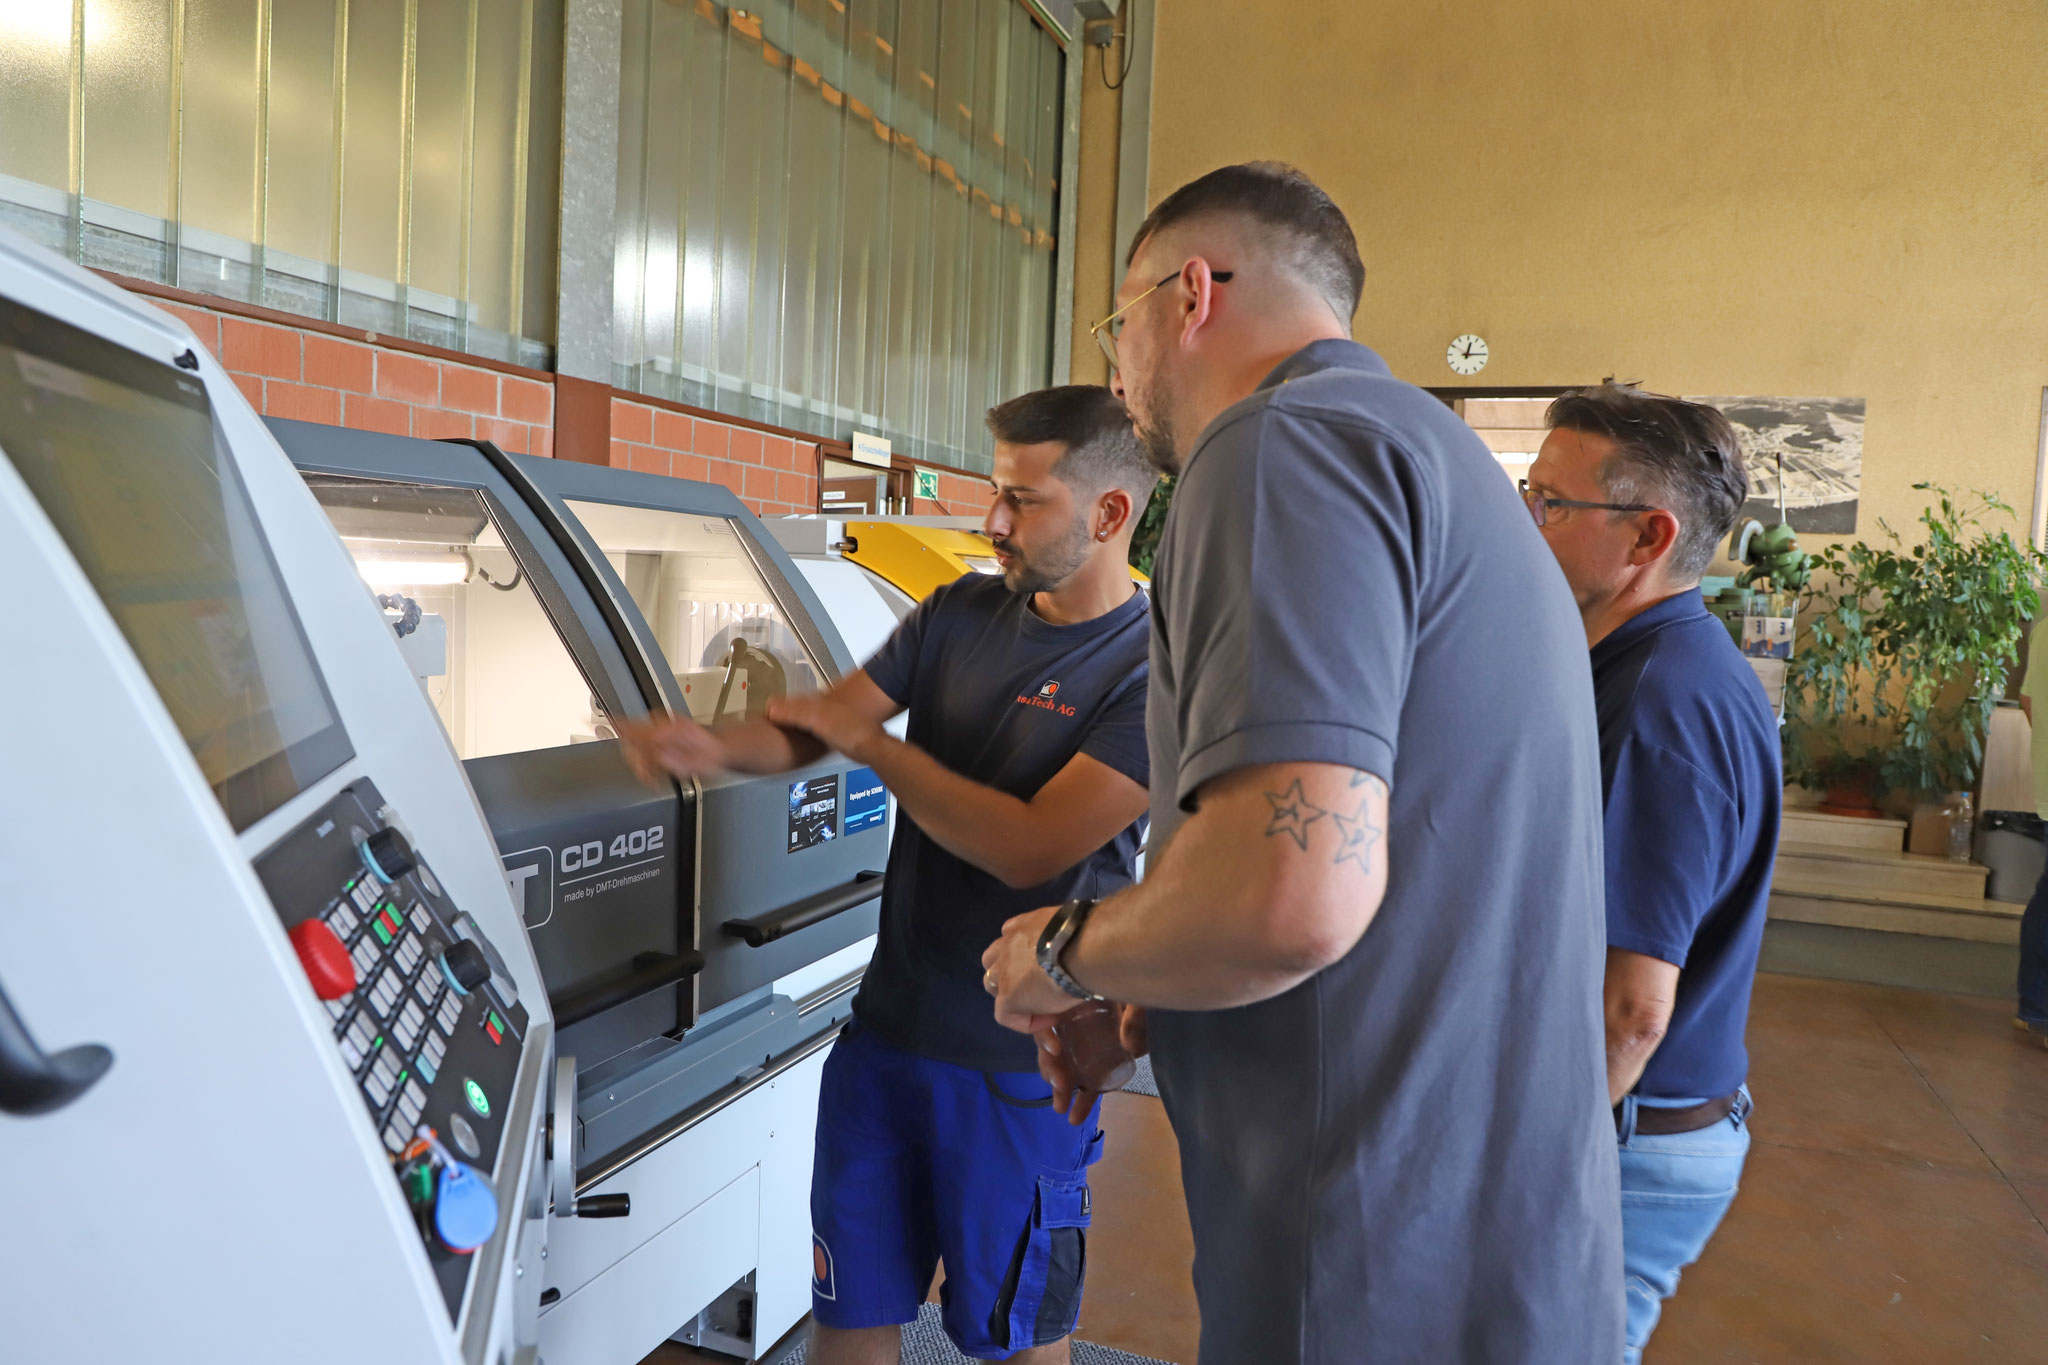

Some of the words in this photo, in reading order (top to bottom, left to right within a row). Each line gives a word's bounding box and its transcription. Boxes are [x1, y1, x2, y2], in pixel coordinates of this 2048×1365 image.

[1057, 703, 1076, 717] AG
[560, 840, 603, 873] CD
[609, 825, 664, 859] 402
[564, 888, 585, 903] made
[586, 886, 595, 899] by
[596, 867, 660, 894] DMT-Drehmaschinen
